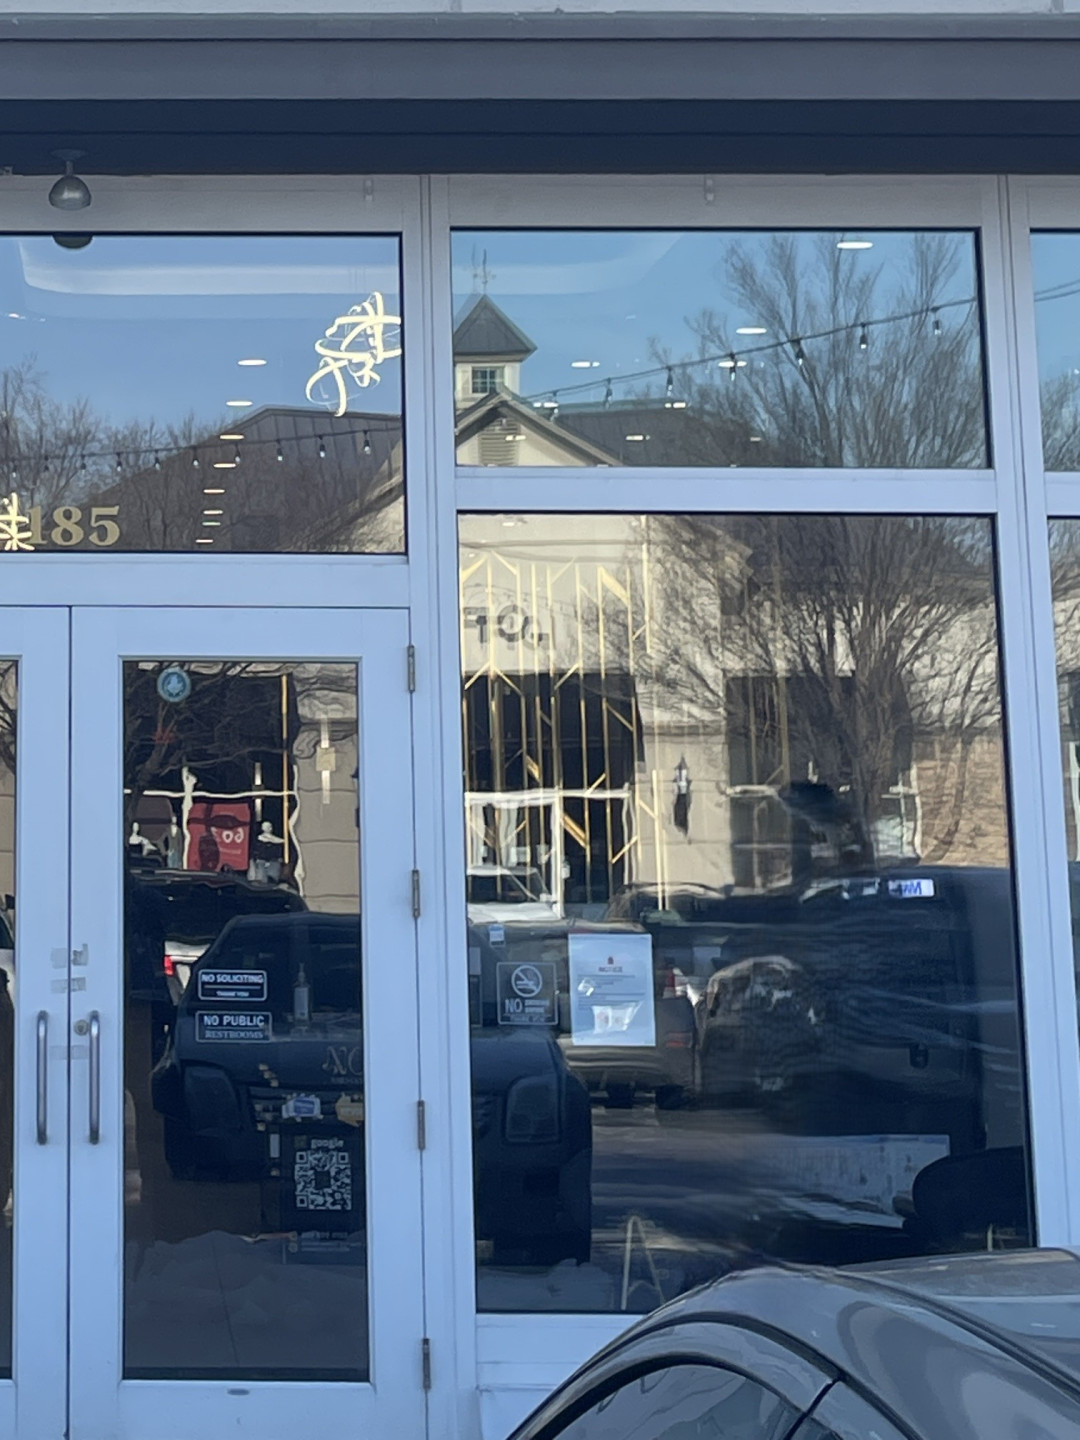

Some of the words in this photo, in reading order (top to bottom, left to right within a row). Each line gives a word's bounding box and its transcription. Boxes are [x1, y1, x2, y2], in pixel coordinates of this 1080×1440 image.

[26, 505, 120, 547] 185
[202, 974, 216, 982] NO
[216, 974, 264, 983] SOLICITING
[505, 998, 523, 1013] NO
[204, 1015, 219, 1025] NO
[223, 1015, 265, 1026] PUBLIC
[205, 1030, 264, 1039] RESTROOMS
